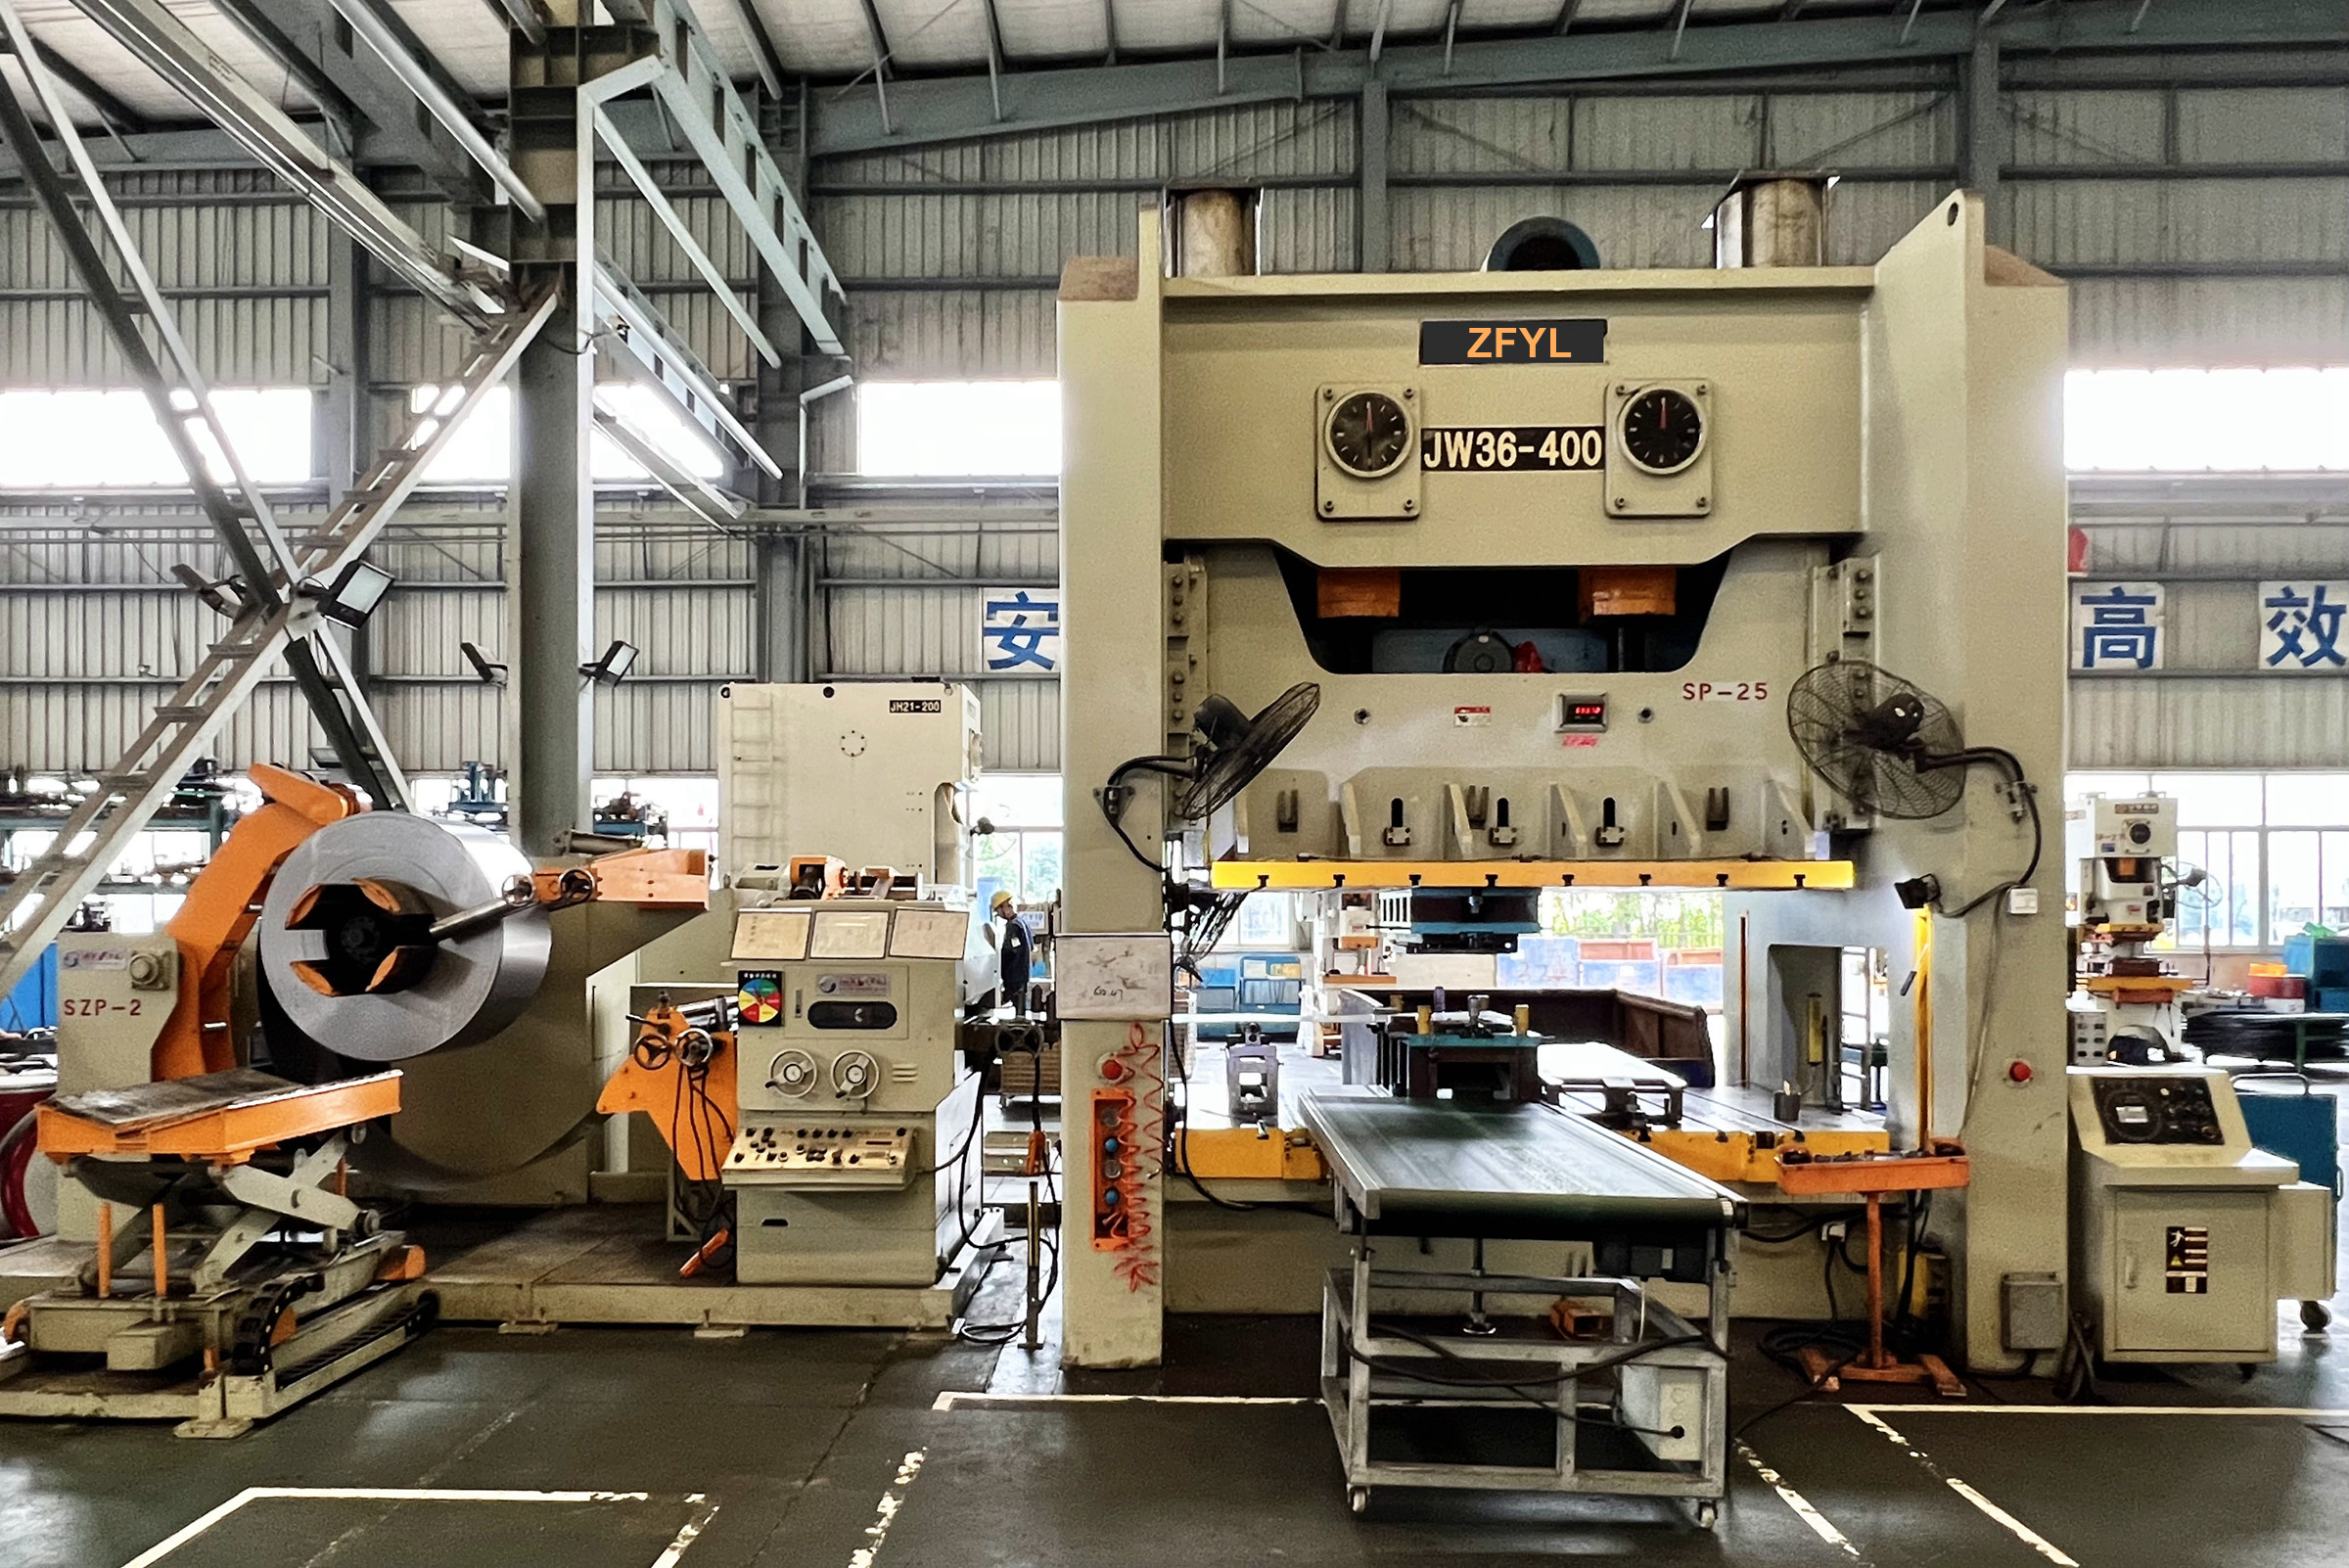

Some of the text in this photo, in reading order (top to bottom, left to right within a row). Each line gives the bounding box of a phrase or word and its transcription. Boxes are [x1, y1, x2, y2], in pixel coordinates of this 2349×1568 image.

[1467, 328, 1572, 358] ZFYL
[1423, 430, 1602, 469] JW36-400
[984, 591, 1059, 670] 安
[1682, 682, 1768, 701] SP-25
[890, 701, 941, 713] JH21-200
[64, 999, 141, 1016] SZP-2
